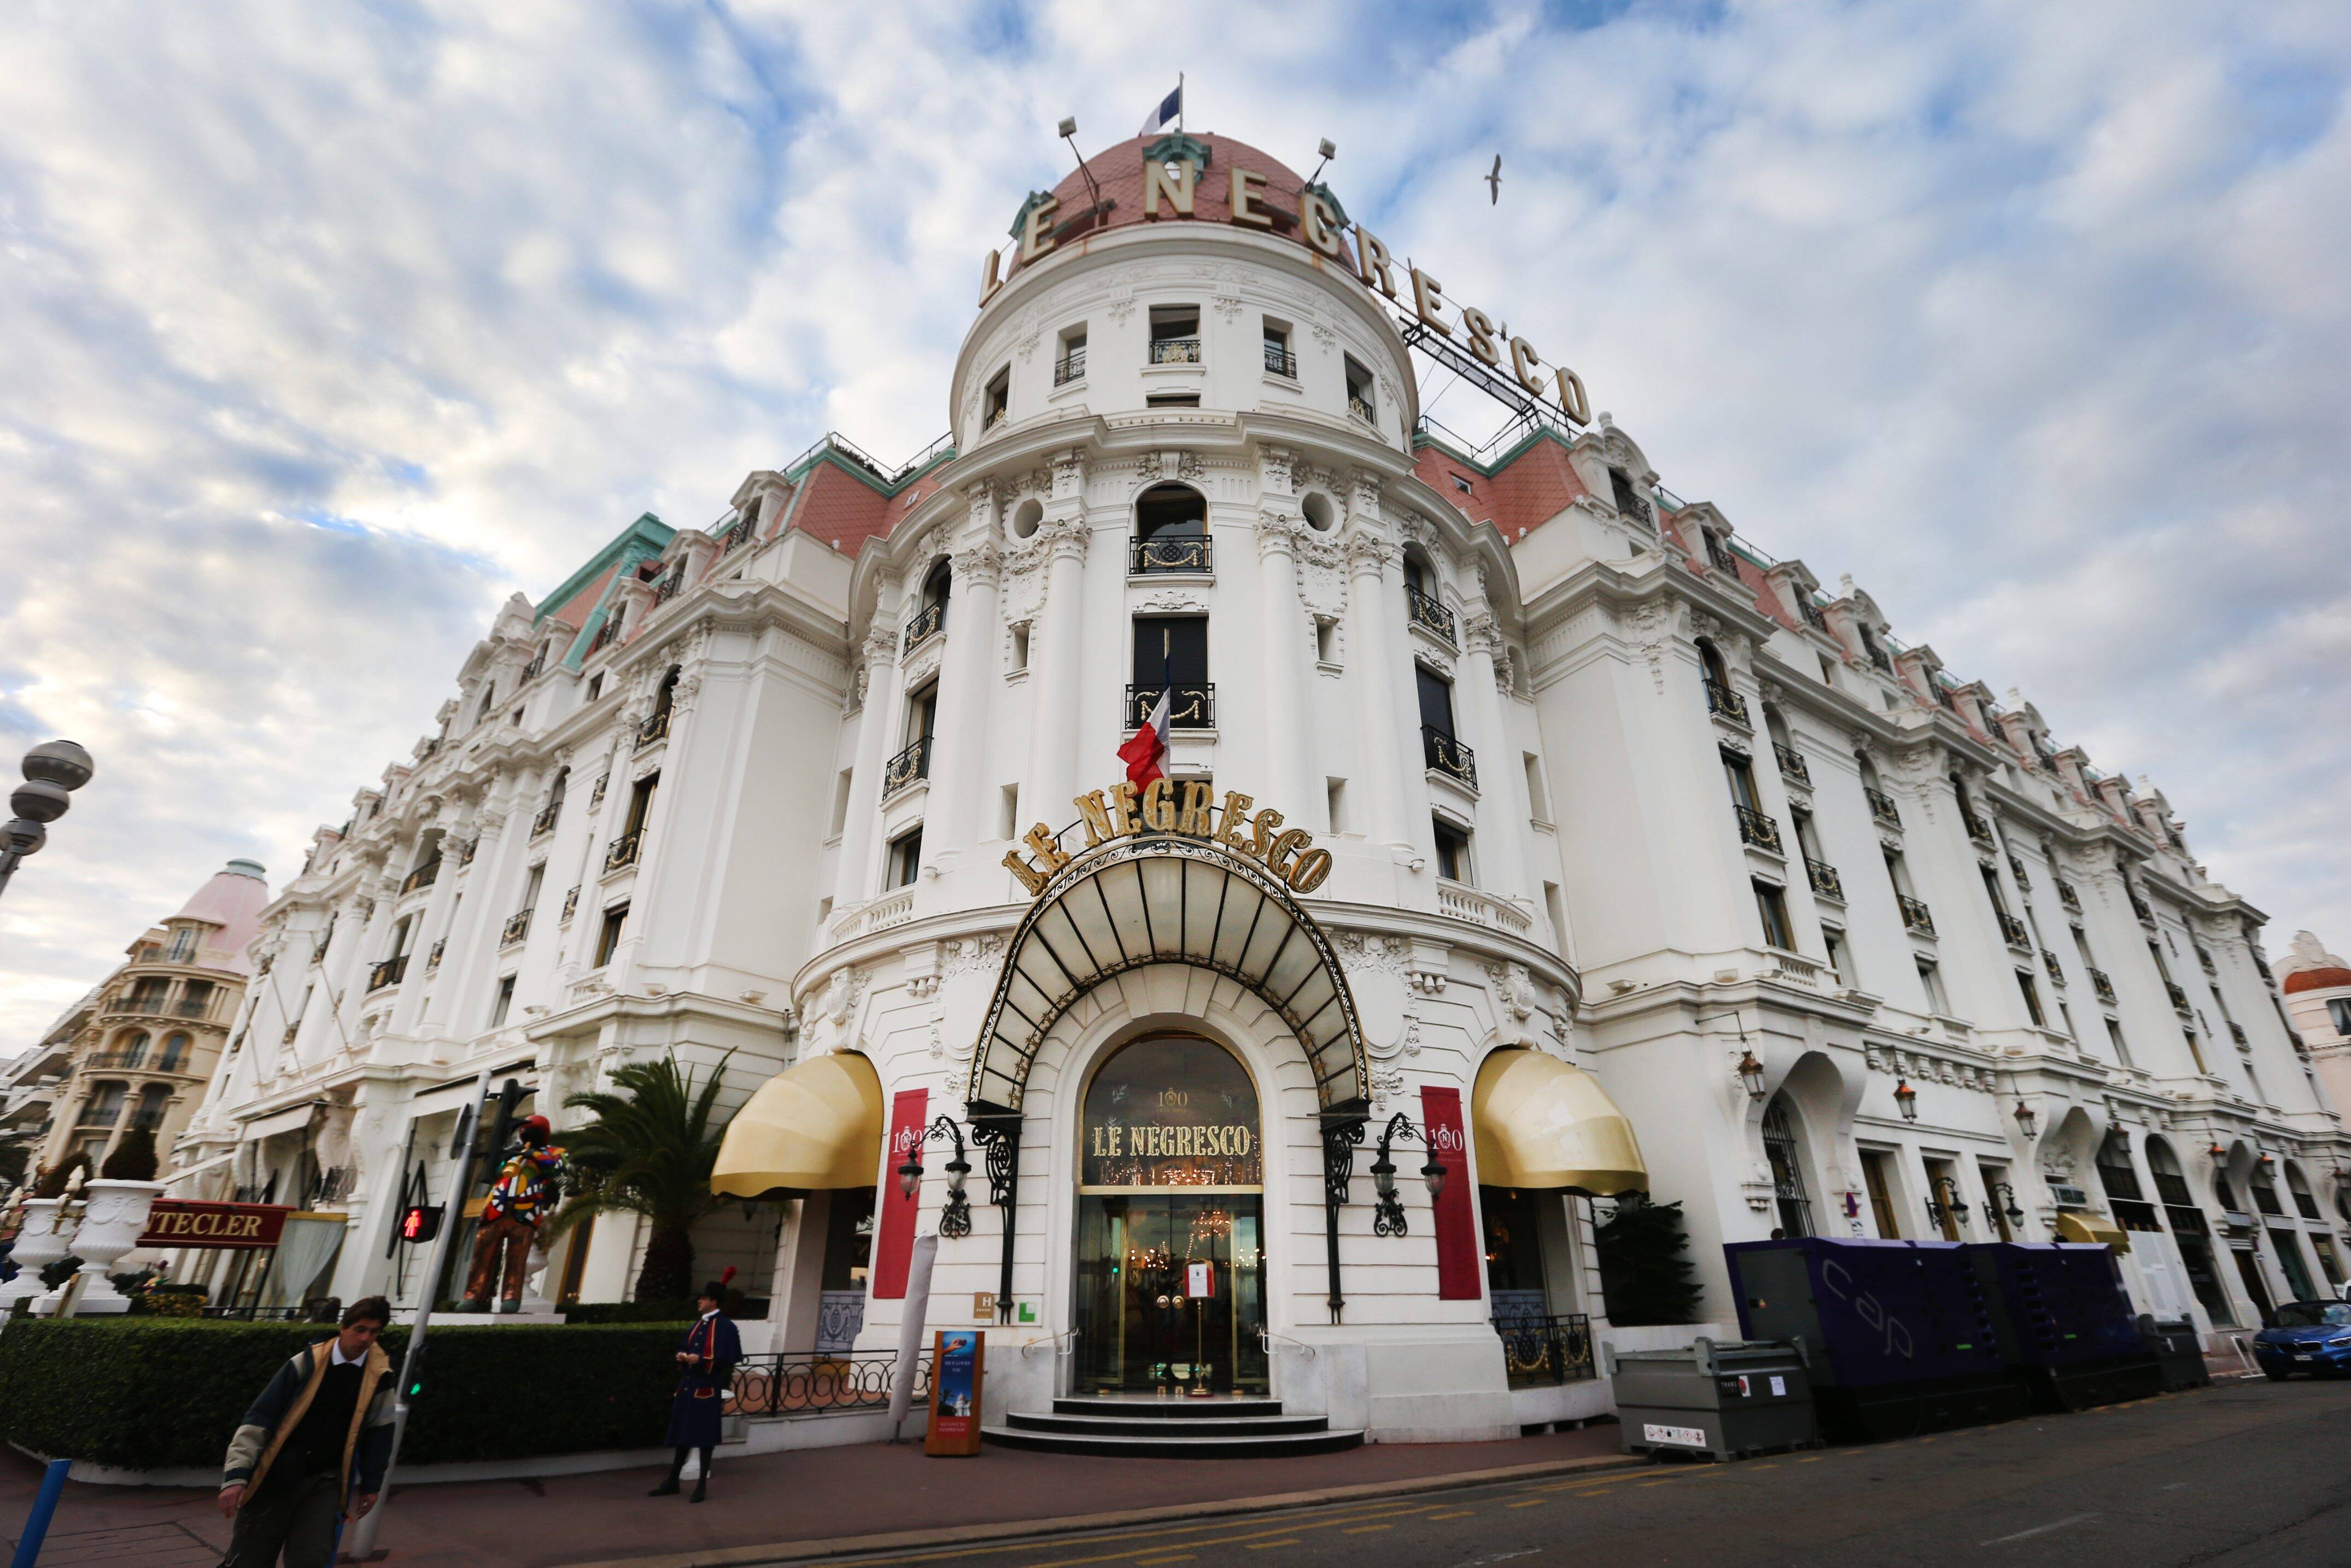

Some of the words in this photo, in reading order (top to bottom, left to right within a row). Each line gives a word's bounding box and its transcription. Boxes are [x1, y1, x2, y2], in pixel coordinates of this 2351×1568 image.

[979, 196, 1061, 308] LE
[1144, 160, 1592, 426] NEGRESCO
[1001, 822, 1072, 897] LE
[1073, 777, 1332, 894] NEGRESCO
[1093, 1126, 1122, 1156] LE
[1130, 1125, 1250, 1156] NEGRESCO
